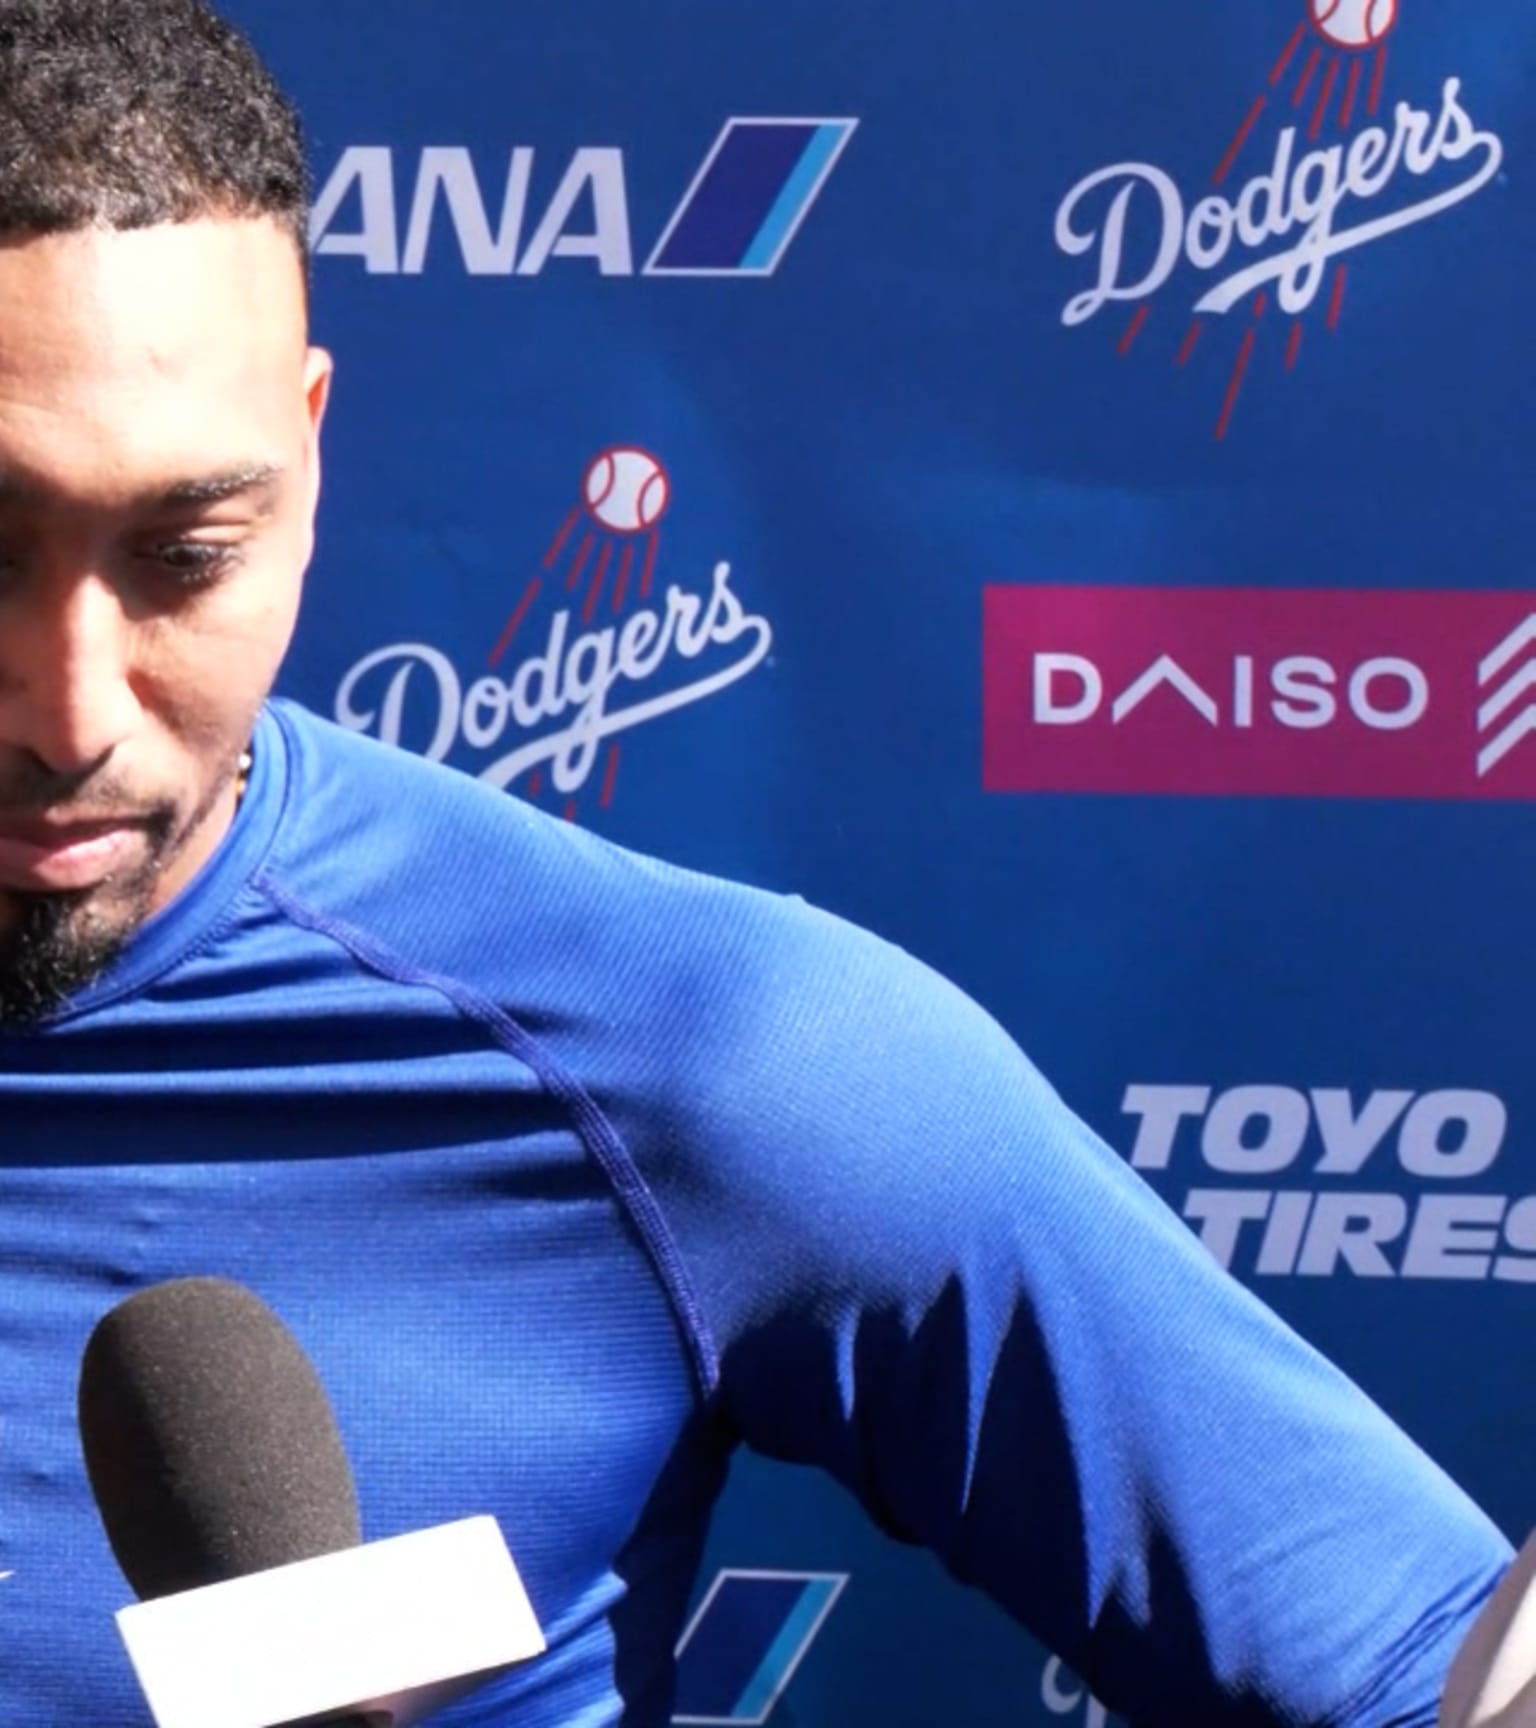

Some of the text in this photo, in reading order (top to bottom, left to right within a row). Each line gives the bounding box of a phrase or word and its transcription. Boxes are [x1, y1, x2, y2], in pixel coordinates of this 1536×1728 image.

[307, 146, 632, 275] ANA
[1055, 76, 1503, 326] Dodgers
[335, 561, 772, 793] Dodgers
[1033, 652, 1429, 729] DAISO
[1120, 1084, 1507, 1177] TOYO
